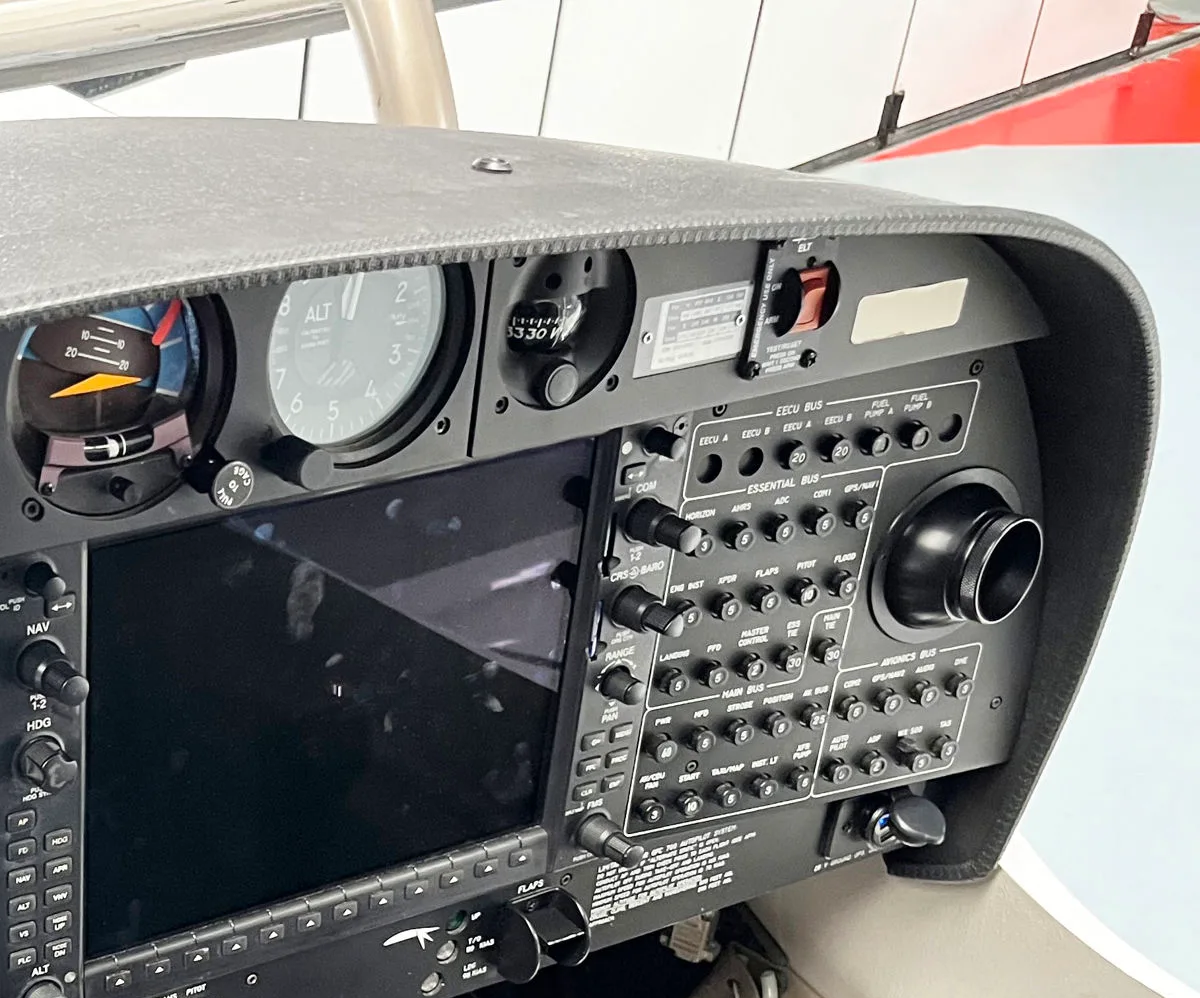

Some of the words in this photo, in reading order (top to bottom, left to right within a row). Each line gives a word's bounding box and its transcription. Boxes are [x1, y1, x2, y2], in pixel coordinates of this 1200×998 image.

[394, 281, 408, 302] 2
[304, 303, 332, 323] ALT
[81, 330, 91, 340] 10
[115, 339, 125, 349] 10
[65, 347, 78, 358] 20
[389, 344, 401, 364] 3
[118, 360, 129, 371] 20
[275, 368, 287, 389] 7
[364, 380, 378, 398] 4
[290, 392, 302, 413] 6
[776, 404, 800, 417] EECU
[804, 400, 822, 412] BUS
[327, 400, 339, 420] 5
[792, 452, 805, 463] 20
[835, 446, 849, 457] 20
[229, 481, 239, 493] TO
[636, 481, 657, 494] COM
[747, 478, 795, 494] ESSENTIAL
[801, 474, 819, 486] BUS
[685, 509, 716, 520] HORIZON
[834, 552, 856, 563] FLOOD
[610, 571, 628, 582] CRS
[640, 561, 664, 574] BARO
[755, 567, 779, 578] FLAPS
[27, 621, 50, 636] NAV
[741, 626, 770, 638] MASTER
[605, 646, 635, 661] RANGE
[880, 653, 916, 667] AVIONICS
[920, 648, 937, 660] BUS
[722, 686, 742, 699] MAIN
[747, 684, 764, 695] BUS
[32, 700, 47, 710] 1-2
[763, 693, 793, 704] POSITION
[727, 701, 753, 713] STROBE
[27, 717, 51, 731] HDG
[678, 773, 700, 783] START
[52, 836, 68, 845] HDG
[517, 879, 544, 894] FLAPS
[31, 964, 50, 977] ALT
[186, 983, 206, 996] PITOT
